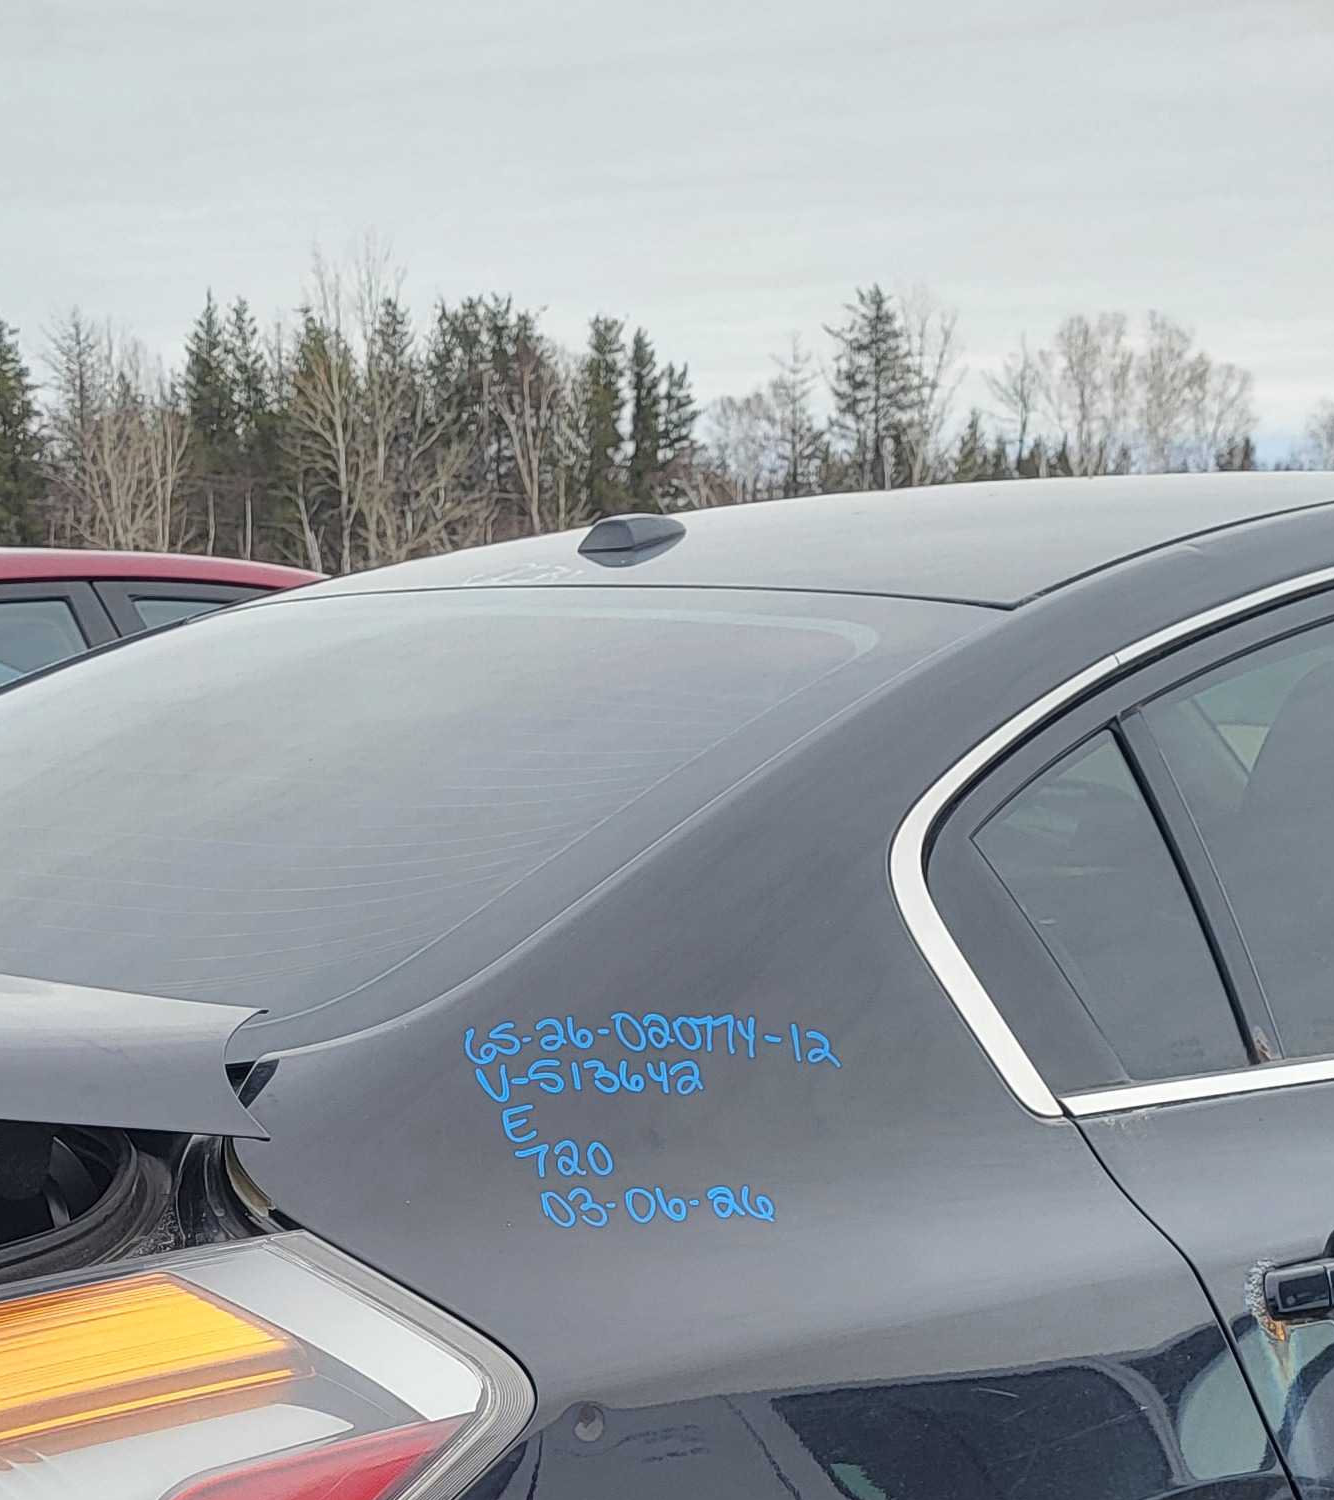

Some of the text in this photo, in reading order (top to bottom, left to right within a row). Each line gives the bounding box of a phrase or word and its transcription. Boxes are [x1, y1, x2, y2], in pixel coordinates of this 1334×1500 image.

[501, 1104, 538, 1143] E
[513, 1139, 614, 1178] 720
[540, 1184, 776, 1229] 03-06-26
